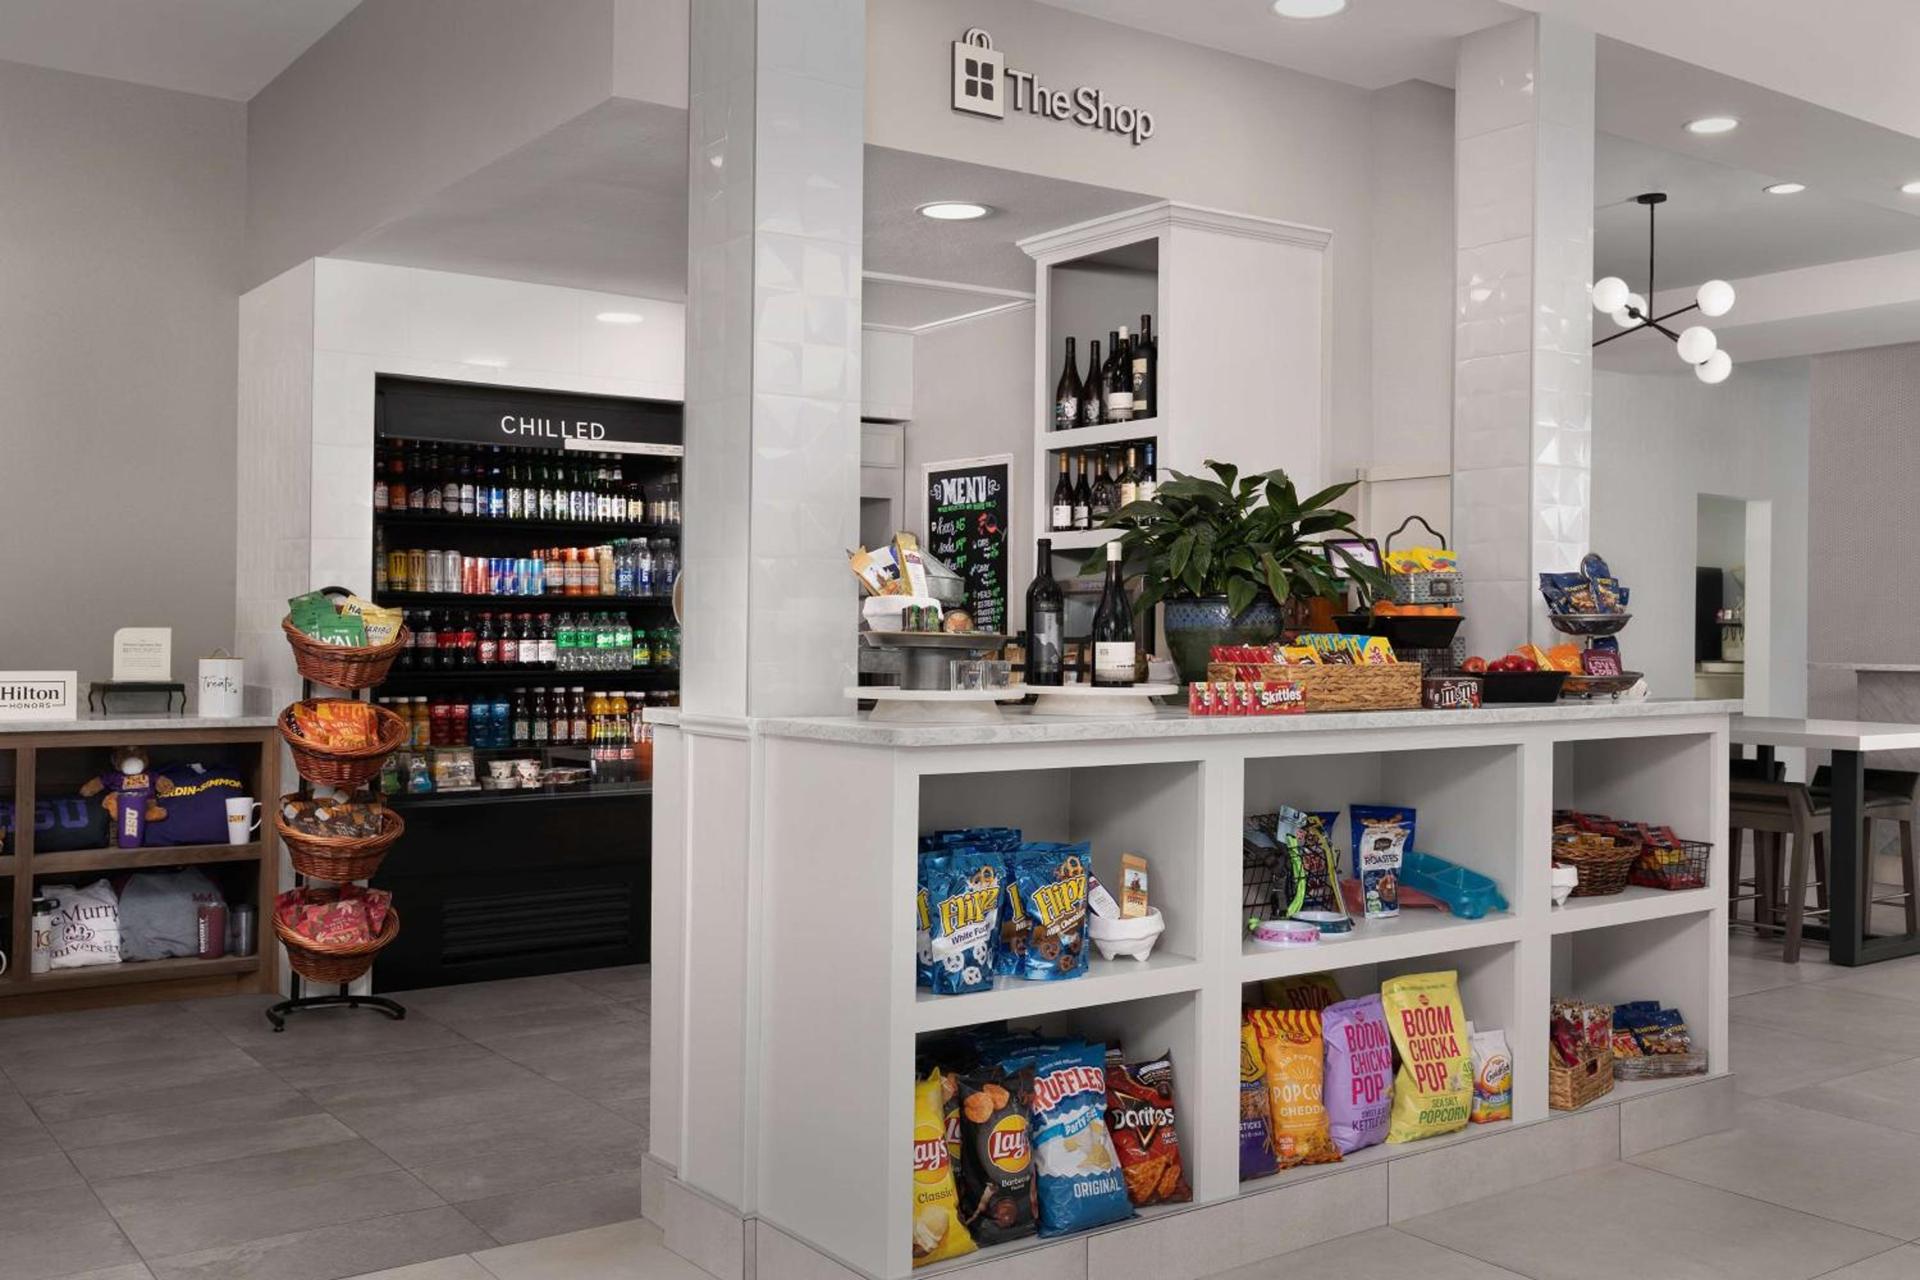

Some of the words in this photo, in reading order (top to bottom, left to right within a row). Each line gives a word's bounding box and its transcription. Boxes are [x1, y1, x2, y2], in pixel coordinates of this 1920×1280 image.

[501, 415, 606, 440] CHILLED
[940, 475, 988, 506] MENU
[1, 686, 60, 701] Hilton
[1261, 688, 1302, 706] Skittles
[50, 904, 119, 928] cMurry
[937, 886, 1000, 938] Flipz
[950, 931, 973, 945] White
[1401, 1005, 1455, 1039] BOOM
[1344, 1020, 1388, 1053] BOOM
[1408, 1034, 1462, 1063] CHICKA
[1351, 1047, 1392, 1076] CHICKA
[1033, 1067, 1105, 1113] RUFFLES
[1352, 1073, 1384, 1105] POP
[1413, 1061, 1449, 1095] POP
[1111, 1105, 1175, 1131] Doritos
[1418, 1104, 1468, 1125] POPCORN
[1064, 1120, 1087, 1137] Party
[1073, 1178, 1122, 1199] ORIGINAL
